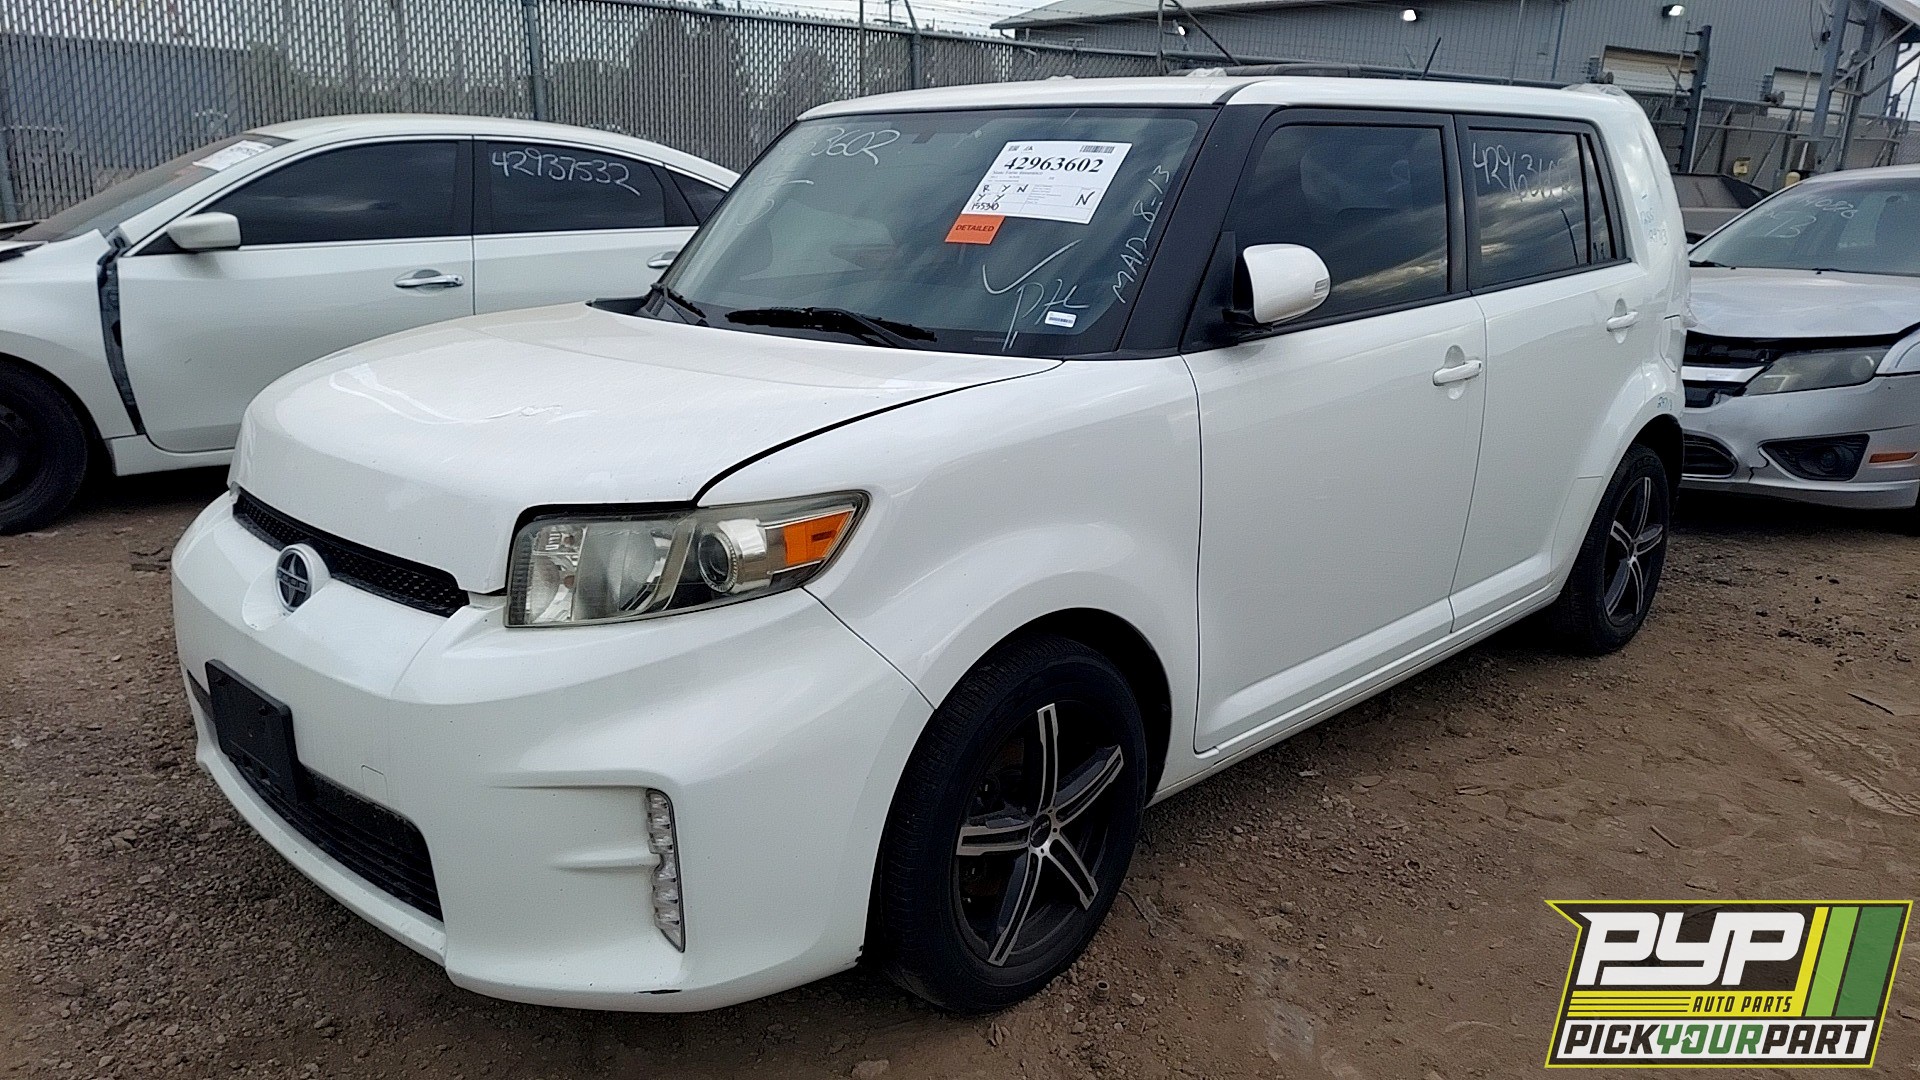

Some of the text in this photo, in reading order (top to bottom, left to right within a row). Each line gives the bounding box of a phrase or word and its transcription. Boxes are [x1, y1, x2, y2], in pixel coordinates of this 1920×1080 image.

[492, 147, 641, 197] 42937532
[1004, 156, 1104, 173] 42963602
[955, 224, 995, 232] DETAILED
